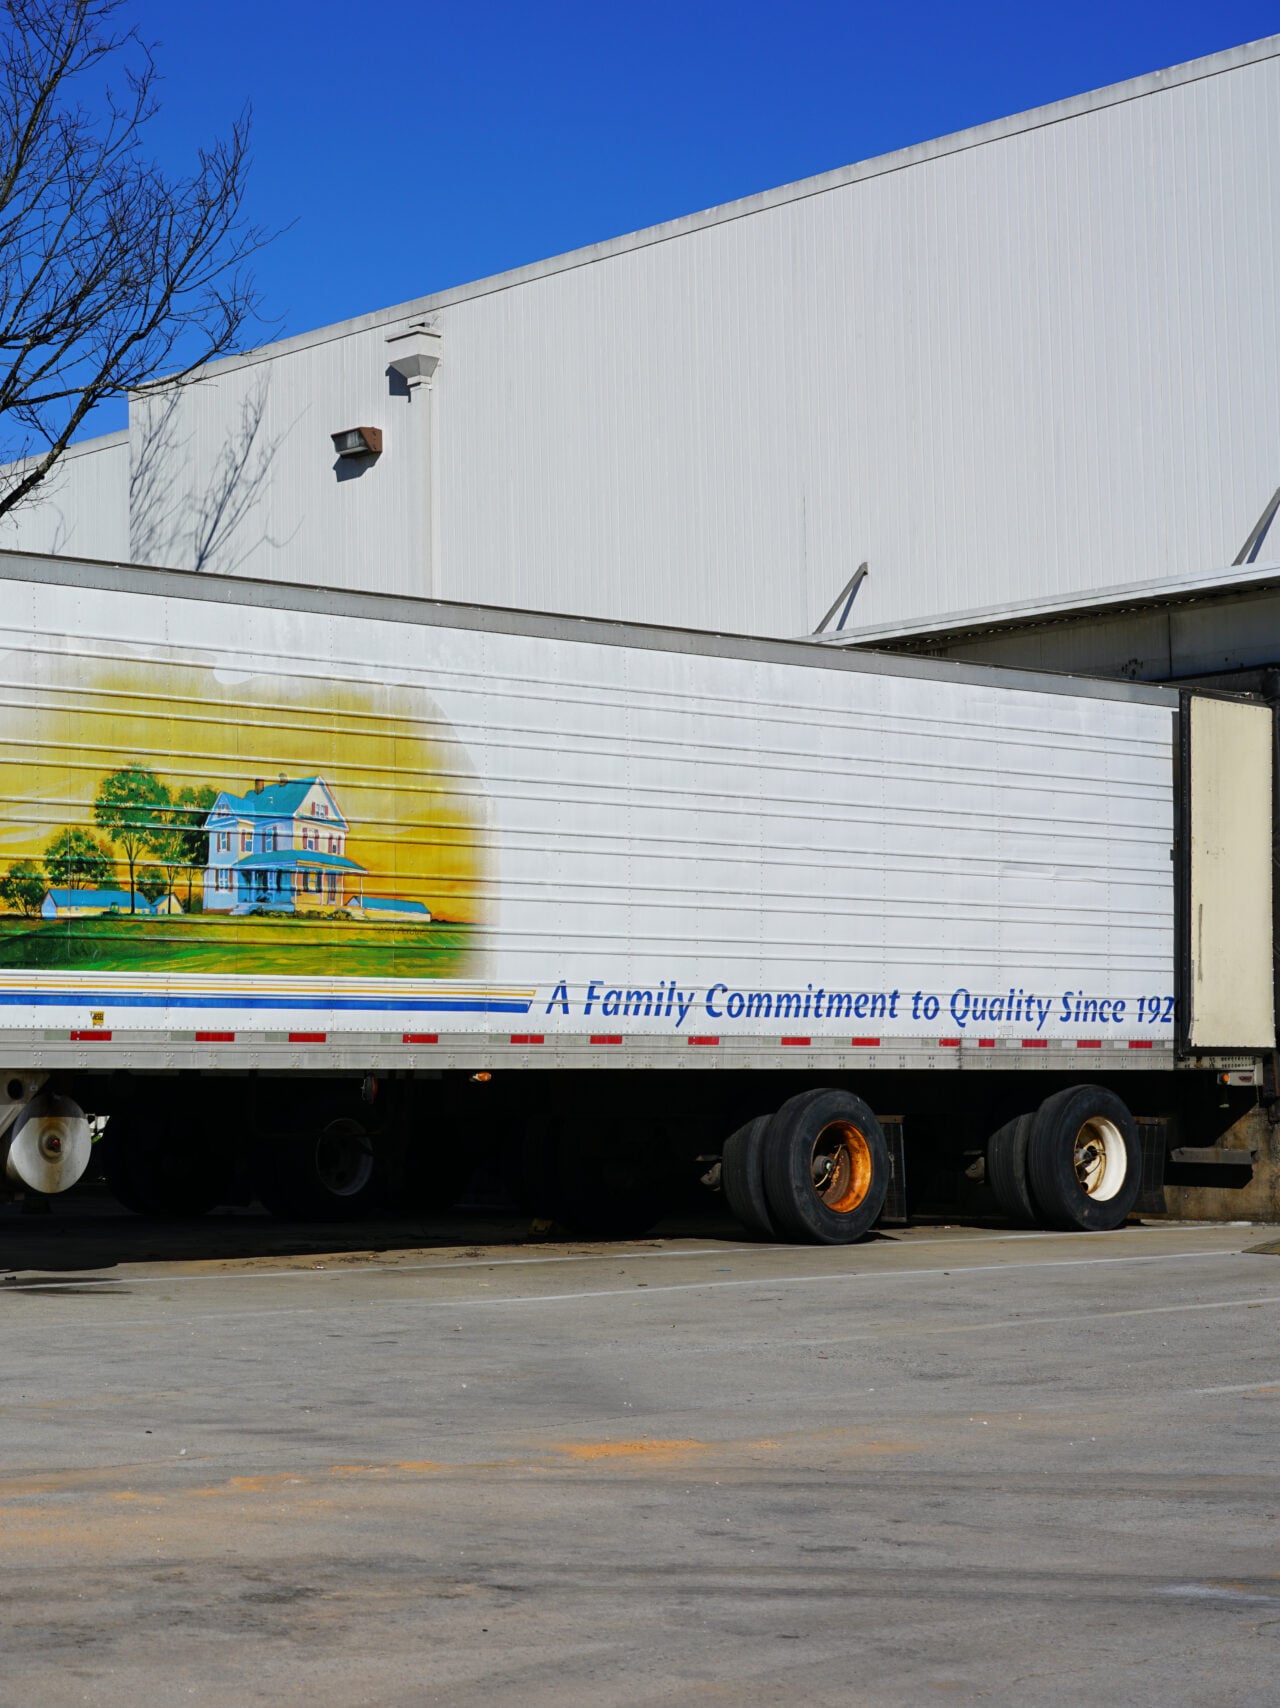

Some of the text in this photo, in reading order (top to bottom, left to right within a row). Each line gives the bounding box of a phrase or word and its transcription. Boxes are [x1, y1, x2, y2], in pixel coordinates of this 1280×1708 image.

[545, 980, 570, 1014] A
[583, 980, 695, 1028] Family
[705, 983, 900, 1019] Commitment
[911, 990, 940, 1020] to
[950, 988, 1052, 1031] Quality
[1059, 990, 1126, 1023] Since
